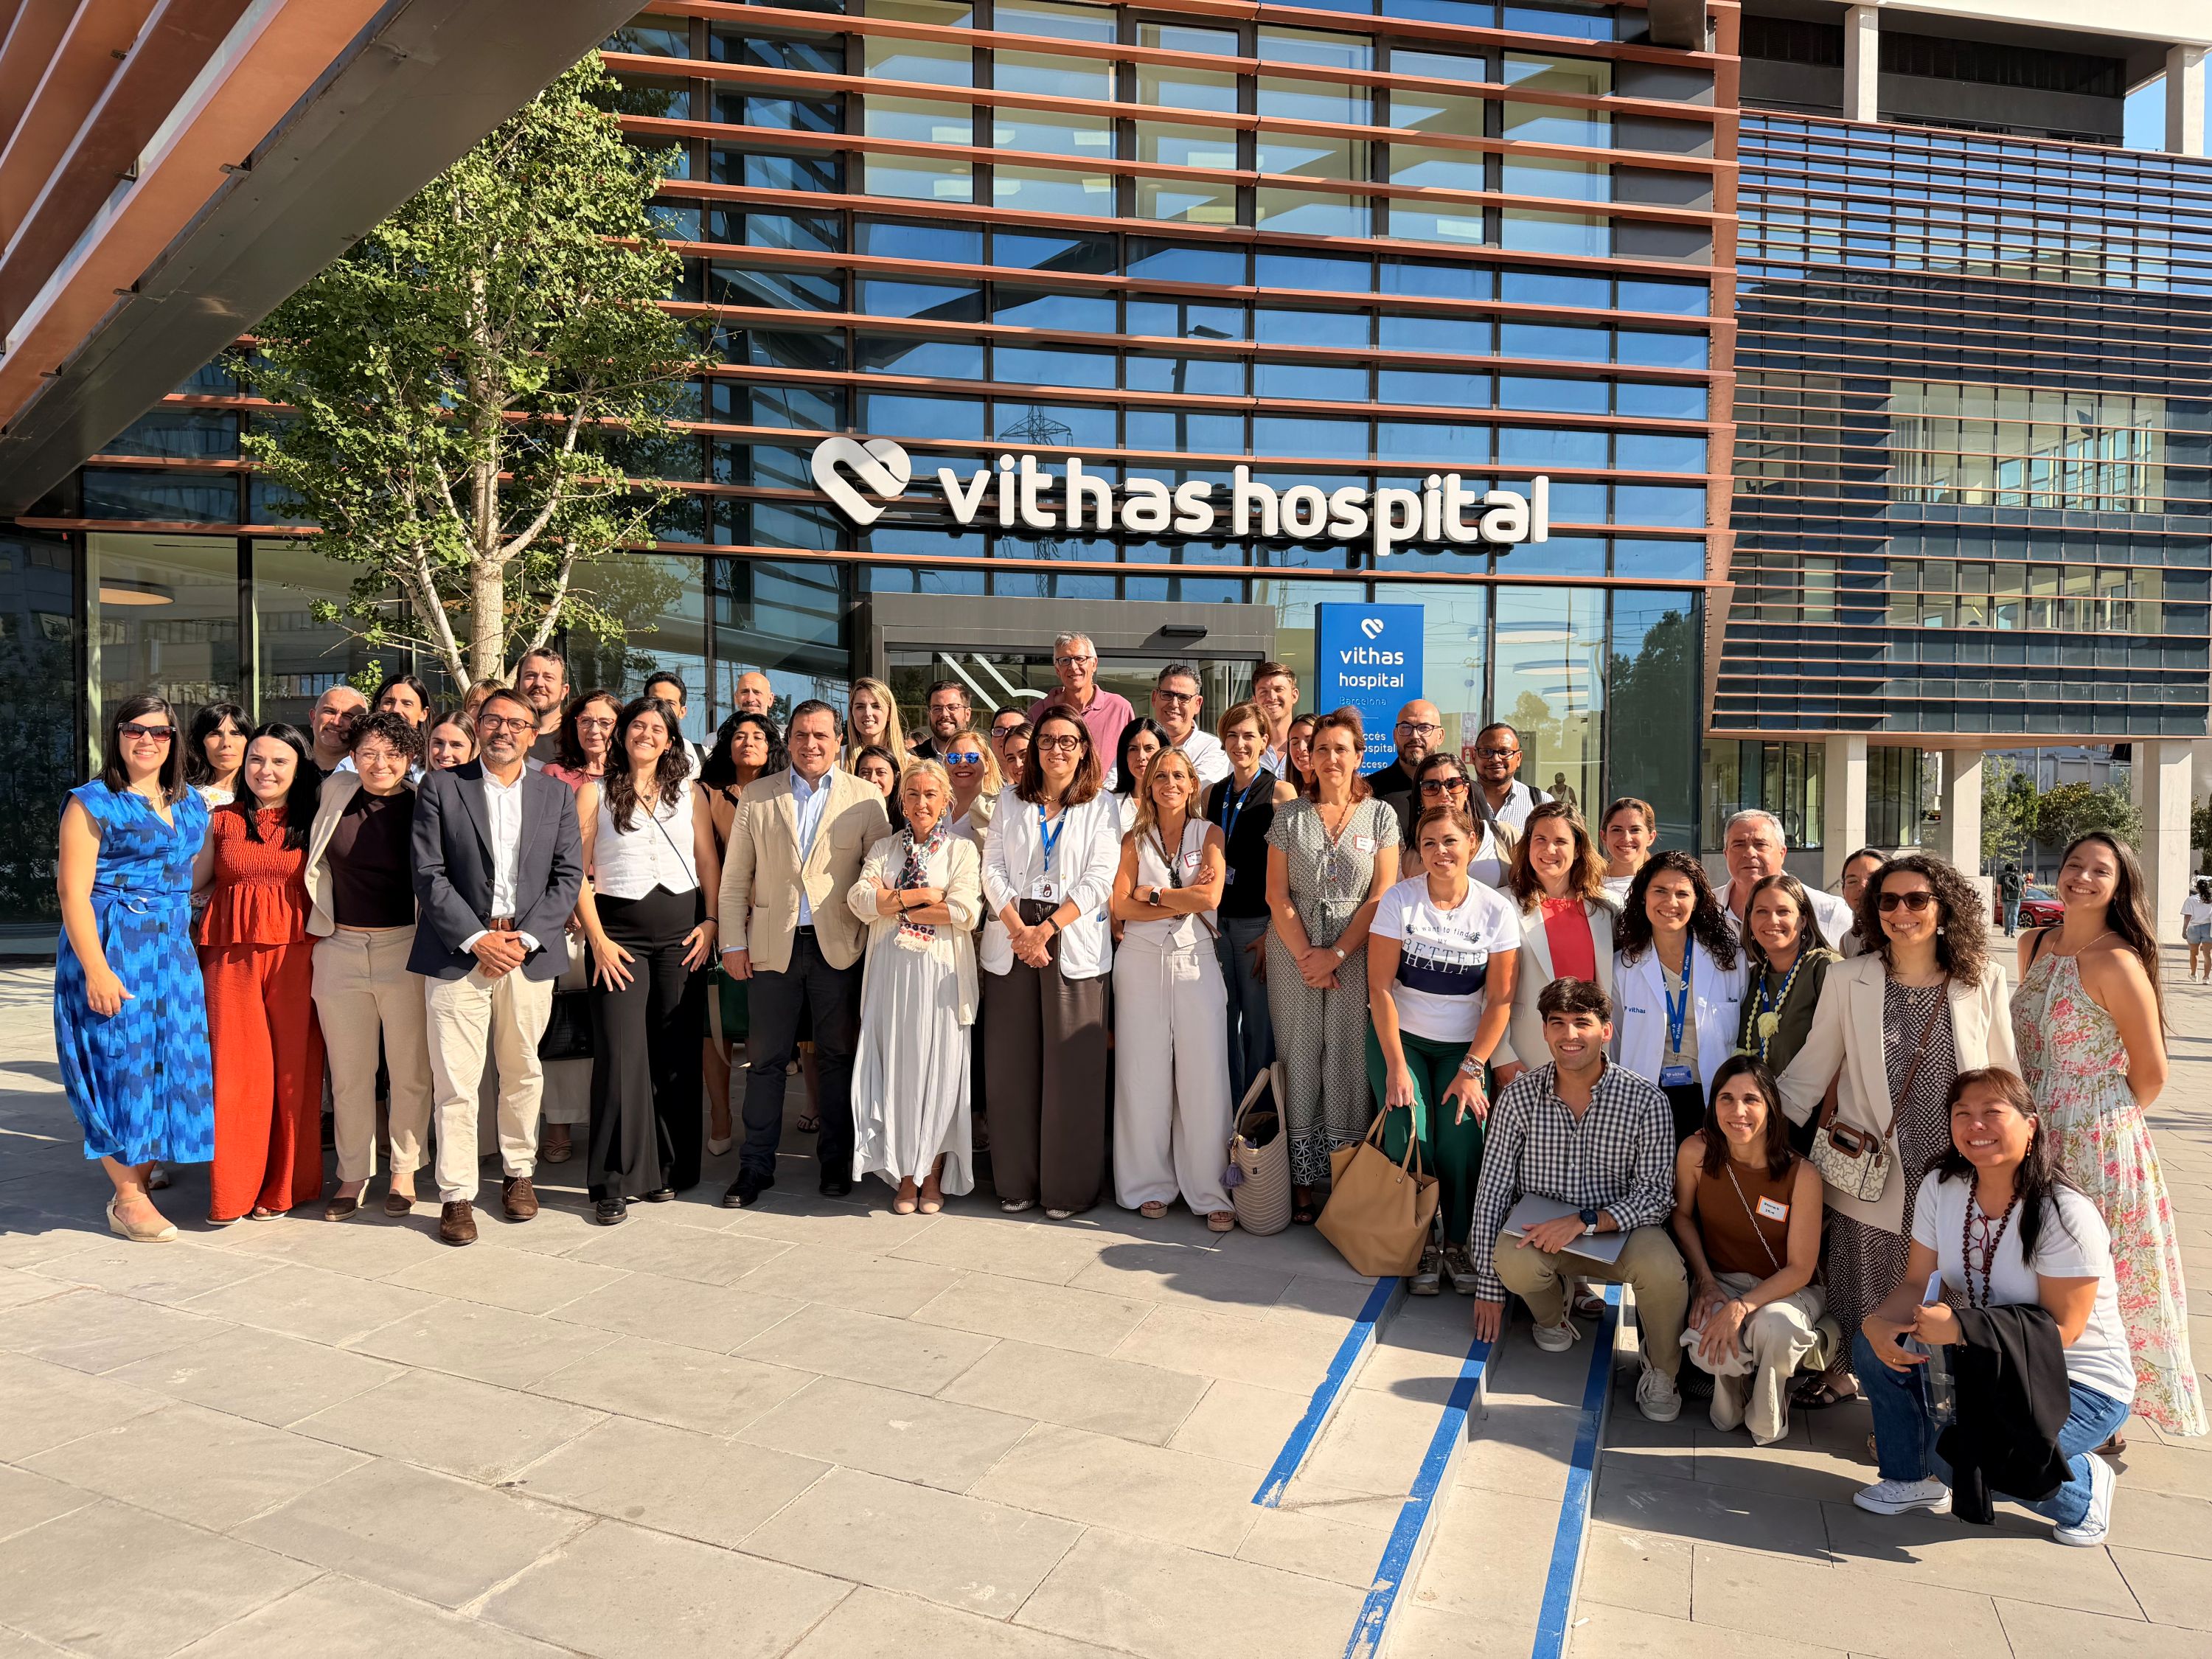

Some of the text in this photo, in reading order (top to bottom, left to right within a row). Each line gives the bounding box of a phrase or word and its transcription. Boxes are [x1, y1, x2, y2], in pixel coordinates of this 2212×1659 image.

[939, 453, 1549, 557] vithas hospital
[1340, 647, 1404, 665] vithas
[1339, 672, 1404, 690] hospital
[1339, 696, 1387, 706] Barcelona
[1362, 731, 1386, 741] ccés
[1363, 743, 1396, 755] ospital
[1454, 928, 1470, 938] find
[1404, 953, 1469, 975] HALF
